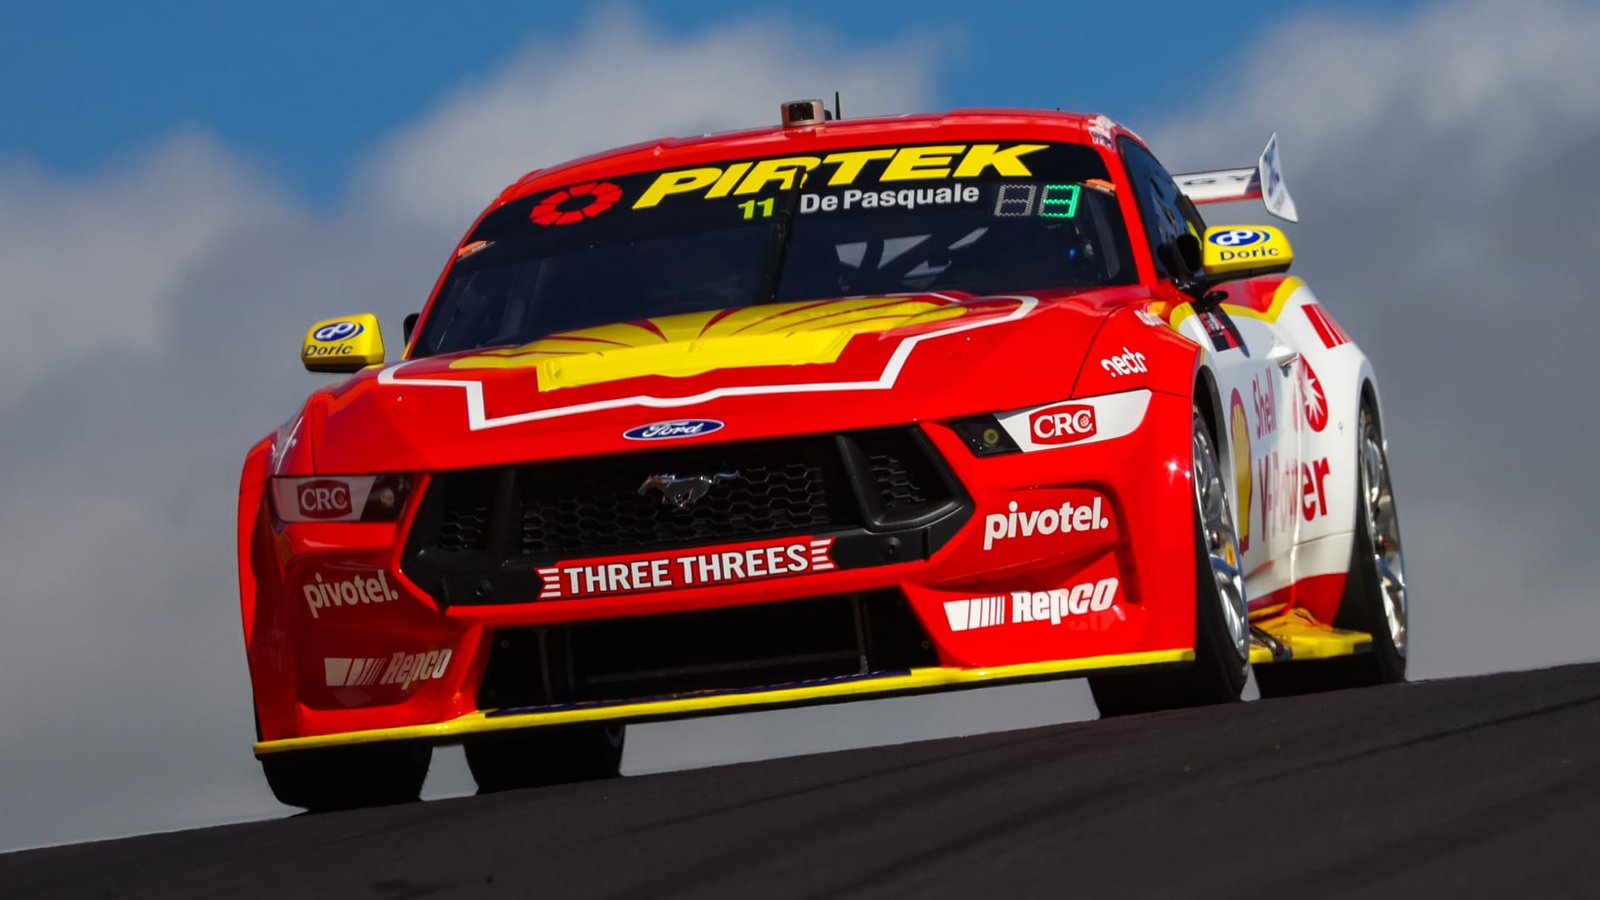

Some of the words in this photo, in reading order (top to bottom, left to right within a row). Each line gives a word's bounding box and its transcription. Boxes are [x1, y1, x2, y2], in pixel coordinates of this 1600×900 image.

[632, 144, 1050, 210] PIRTEK
[738, 197, 774, 220] 11
[800, 192, 838, 214] De
[843, 183, 980, 210] Pasquale
[1220, 247, 1279, 261] Doric
[305, 343, 353, 357] Doric
[1252, 367, 1277, 440] Shell
[642, 421, 704, 438] Ford
[1033, 410, 1094, 439] CRC
[300, 487, 348, 512] CRC
[983, 497, 1109, 550] pivotel.
[563, 559, 672, 594] THREE
[677, 544, 809, 584] THREES
[303, 569, 399, 618] pivotel.
